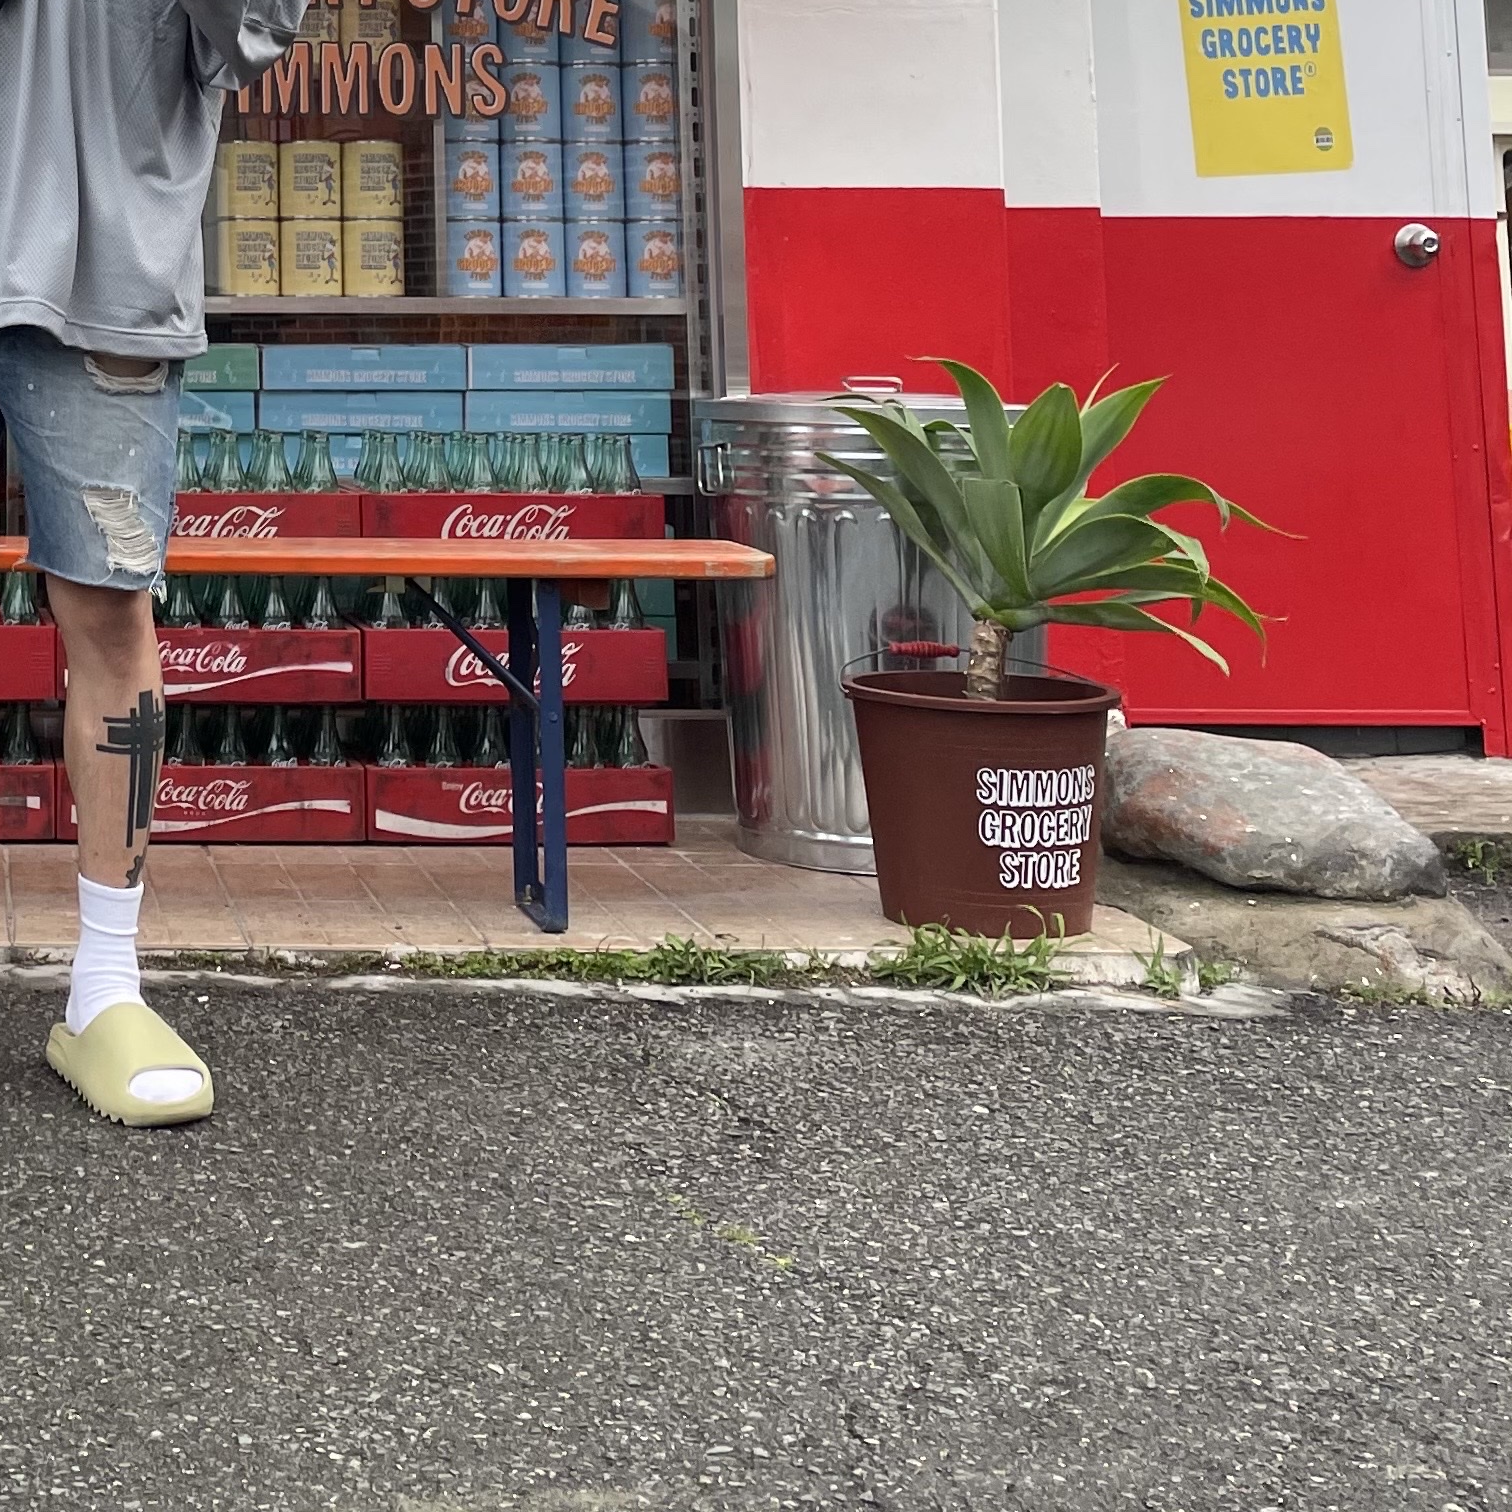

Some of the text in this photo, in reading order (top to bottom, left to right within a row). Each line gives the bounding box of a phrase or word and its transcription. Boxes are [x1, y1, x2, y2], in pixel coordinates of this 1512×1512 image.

[1201, 23, 1321, 59] GROCERY
[169, 505, 287, 539] oca-Cola
[441, 503, 577, 540] Coca-Cola
[976, 764, 1095, 807] SIMMONS
[979, 805, 1092, 848] GROCERY
[1000, 849, 1081, 889] STORE
